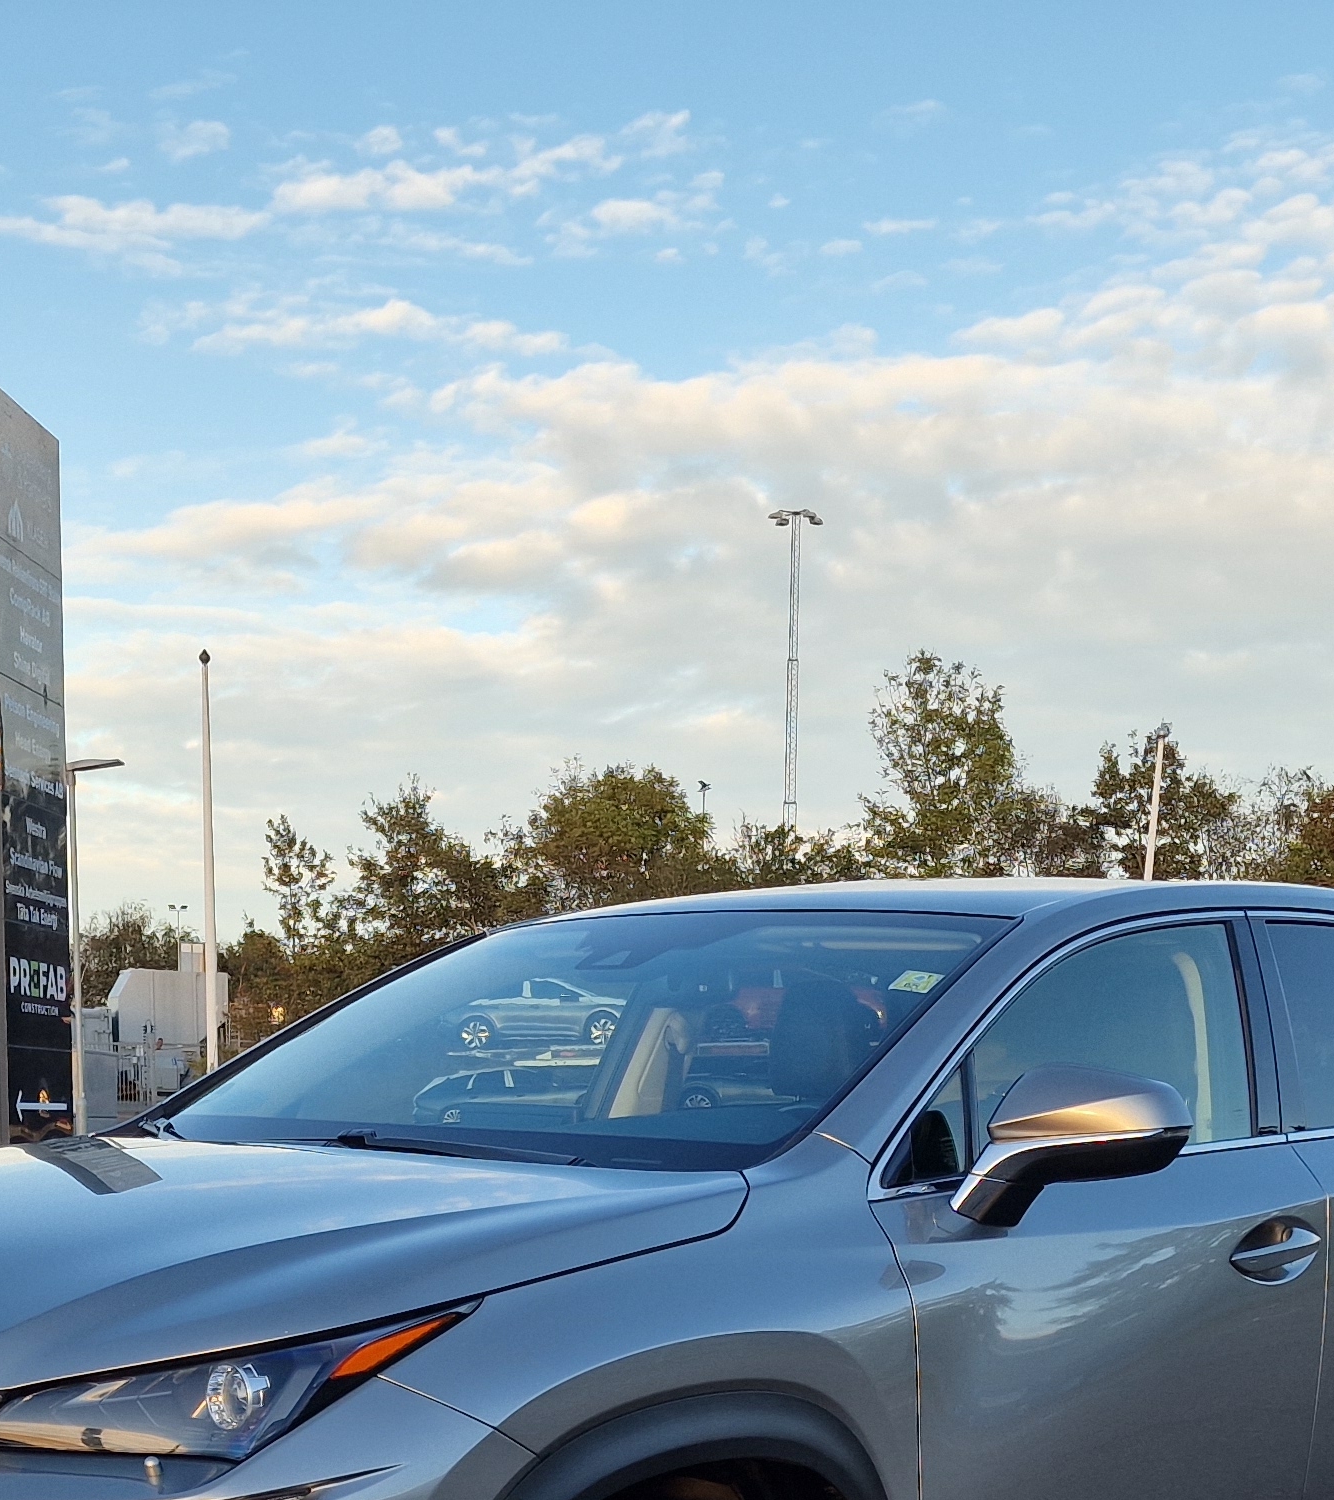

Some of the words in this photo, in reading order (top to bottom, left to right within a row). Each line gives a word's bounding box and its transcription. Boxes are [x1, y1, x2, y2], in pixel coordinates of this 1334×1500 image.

[30, 771, 55, 796] Services
[55, 781, 64, 800] AB
[9, 956, 66, 1001] PREFAB
[20, 1001, 60, 1016] CONSTRUCTION
